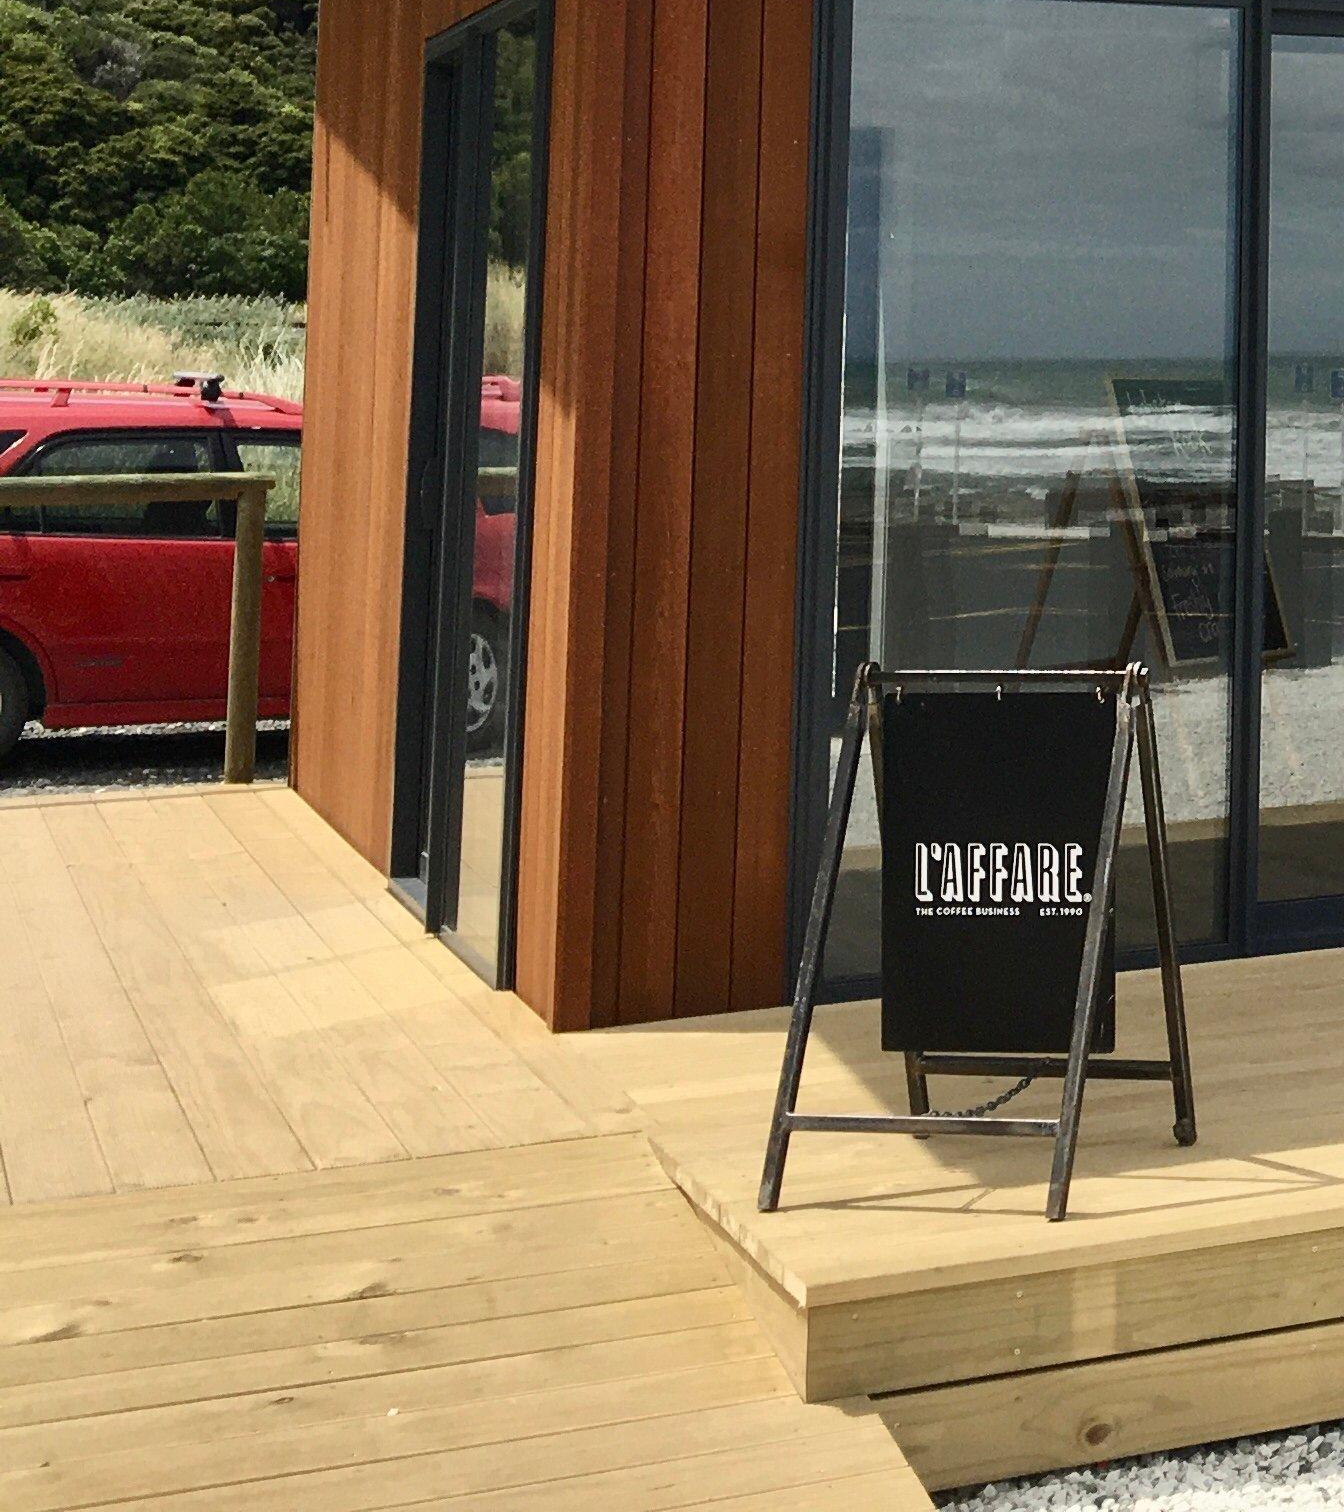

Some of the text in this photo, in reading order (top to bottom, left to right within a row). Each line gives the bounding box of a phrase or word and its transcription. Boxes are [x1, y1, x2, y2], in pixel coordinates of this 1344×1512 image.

[915, 842, 1083, 903] L'AFFARE
[915, 907, 934, 916] THE
[936, 906, 974, 916] COFFEE
[975, 906, 1020, 916] BUSINESS
